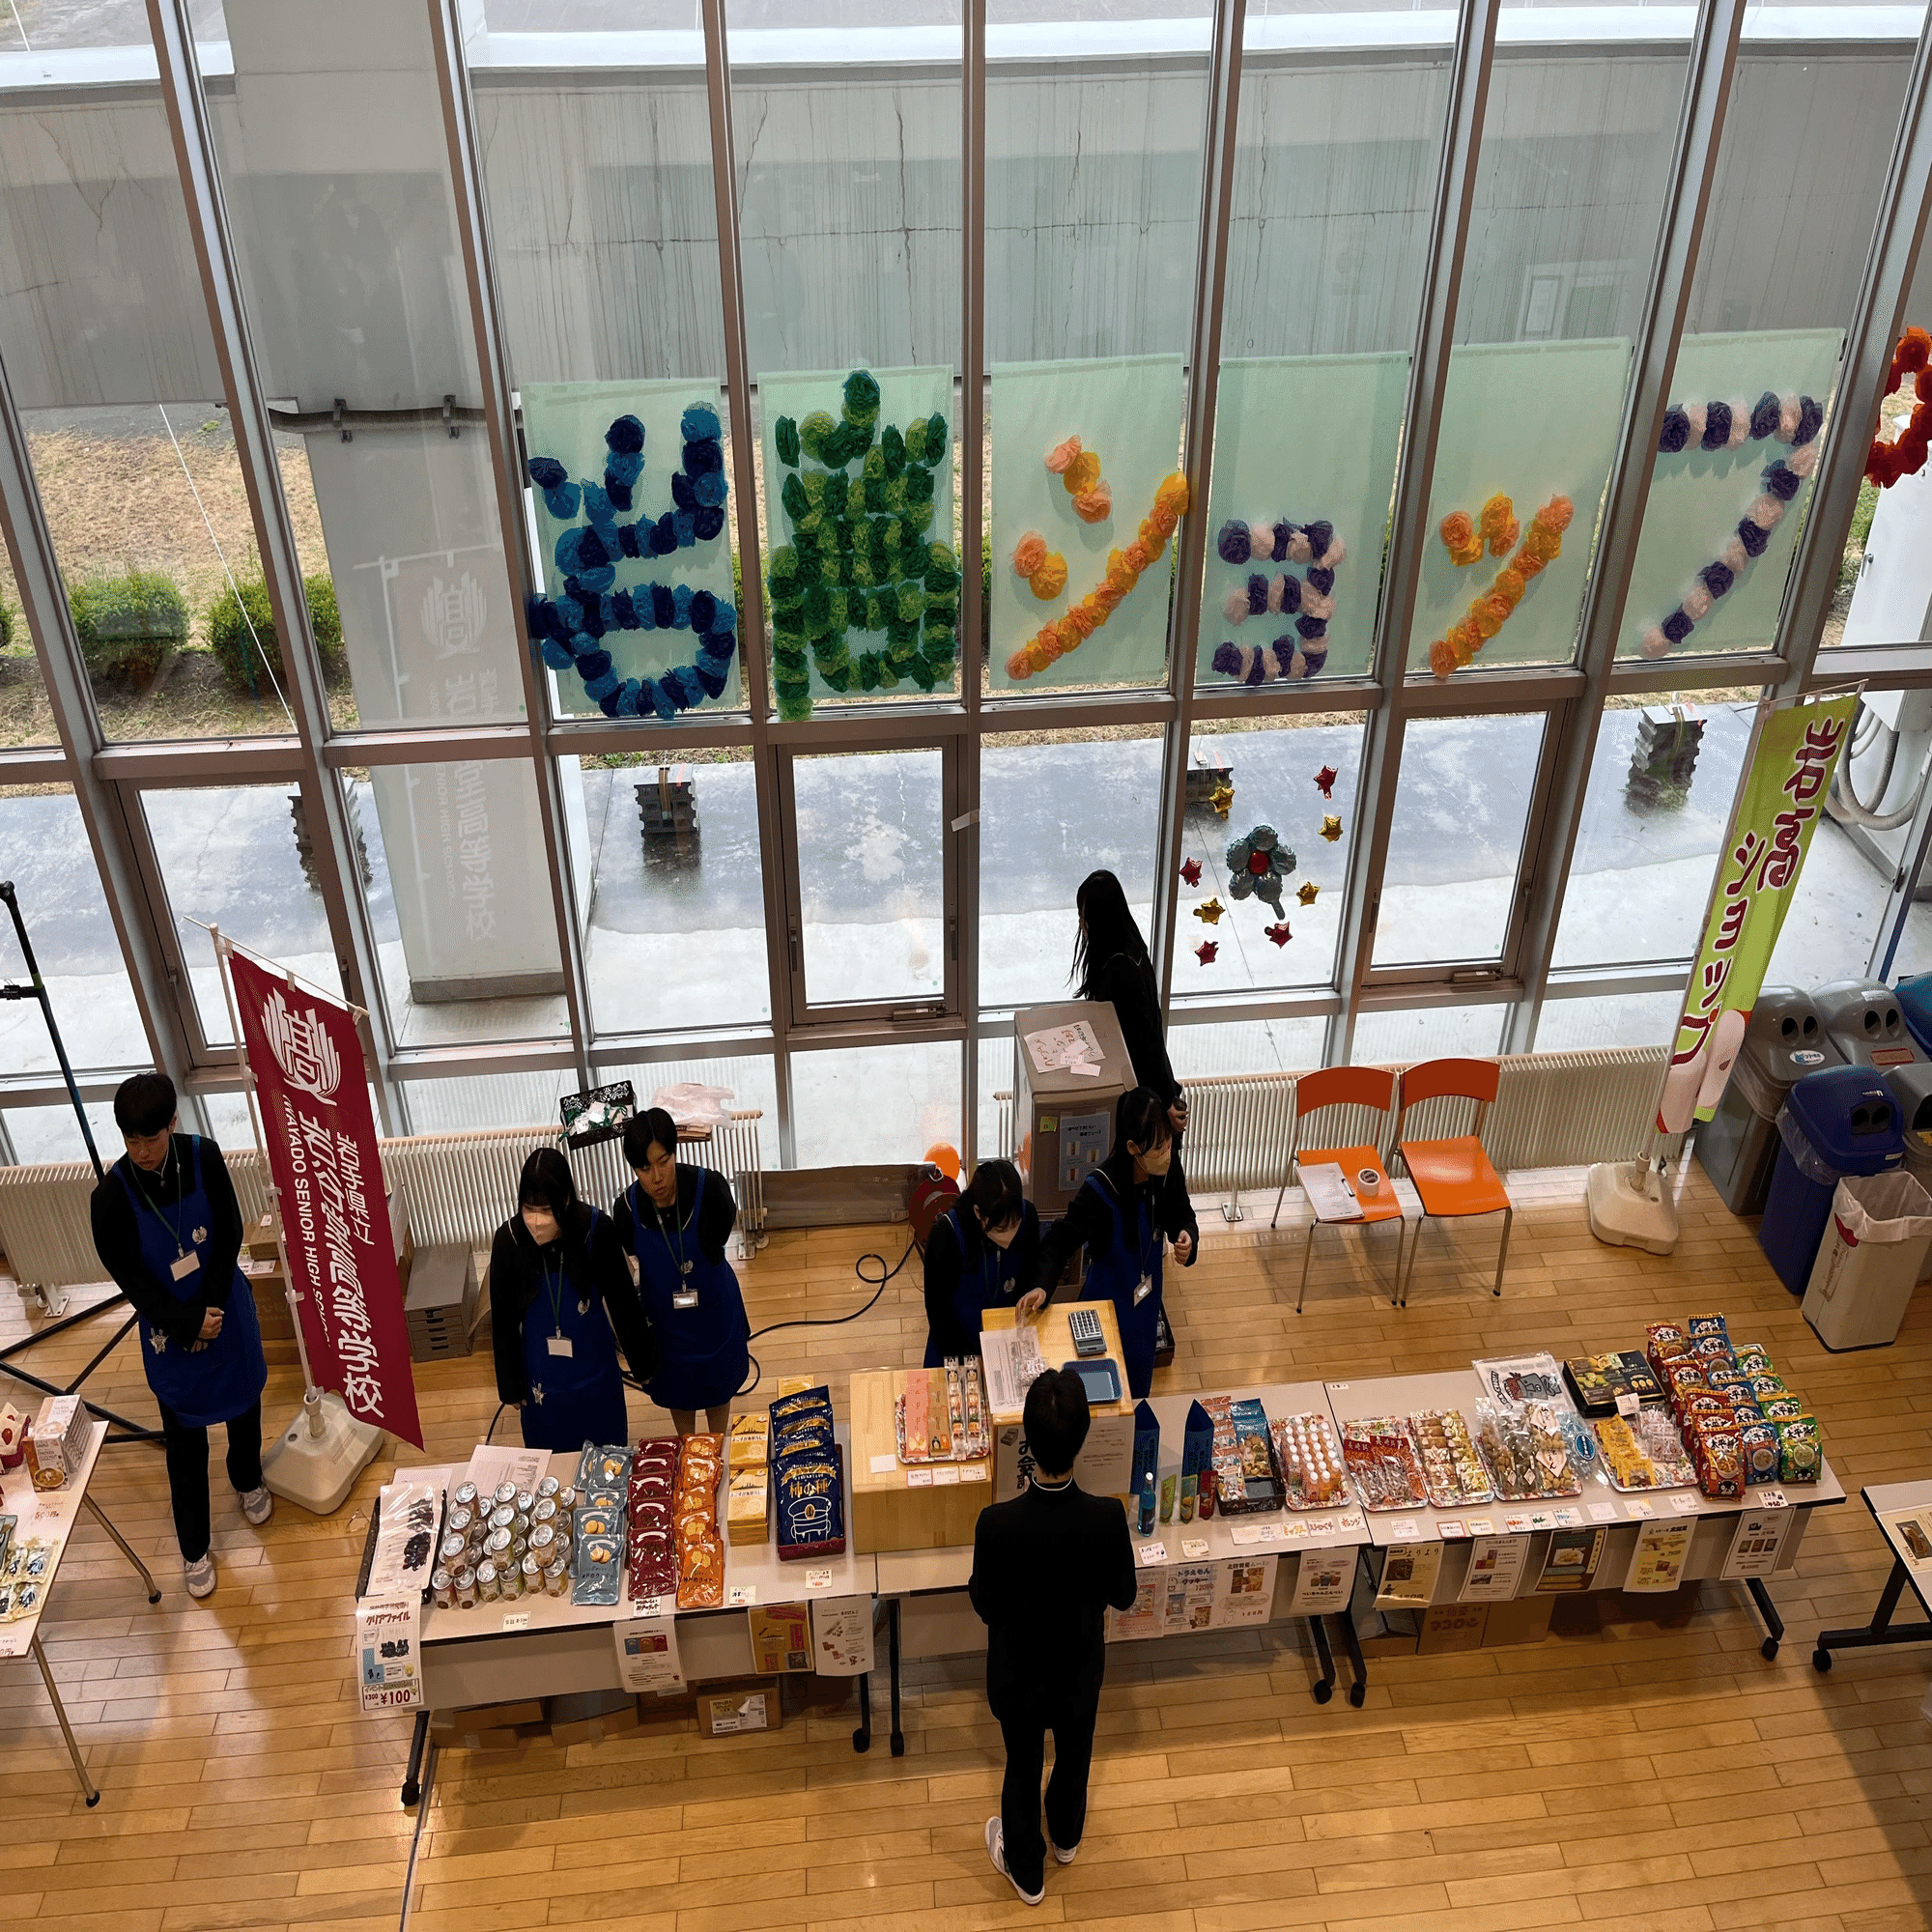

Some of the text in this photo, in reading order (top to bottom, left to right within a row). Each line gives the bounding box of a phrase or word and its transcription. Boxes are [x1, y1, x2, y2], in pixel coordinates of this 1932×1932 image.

[1668, 830, 1768, 1066] ショップ
[293, 1175, 316, 1244] SENIOR
[335, 1130, 377, 1246] 岩手県立
[298, 1109, 385, 1420] 岩谷堂高等学校
[303, 1244, 321, 1289] HIGH
[1178, 1567, 1210, 1577] ドラえもん
[366, 1610, 412, 1626] クリアファイル
[380, 1689, 411, 1705] ¥100
